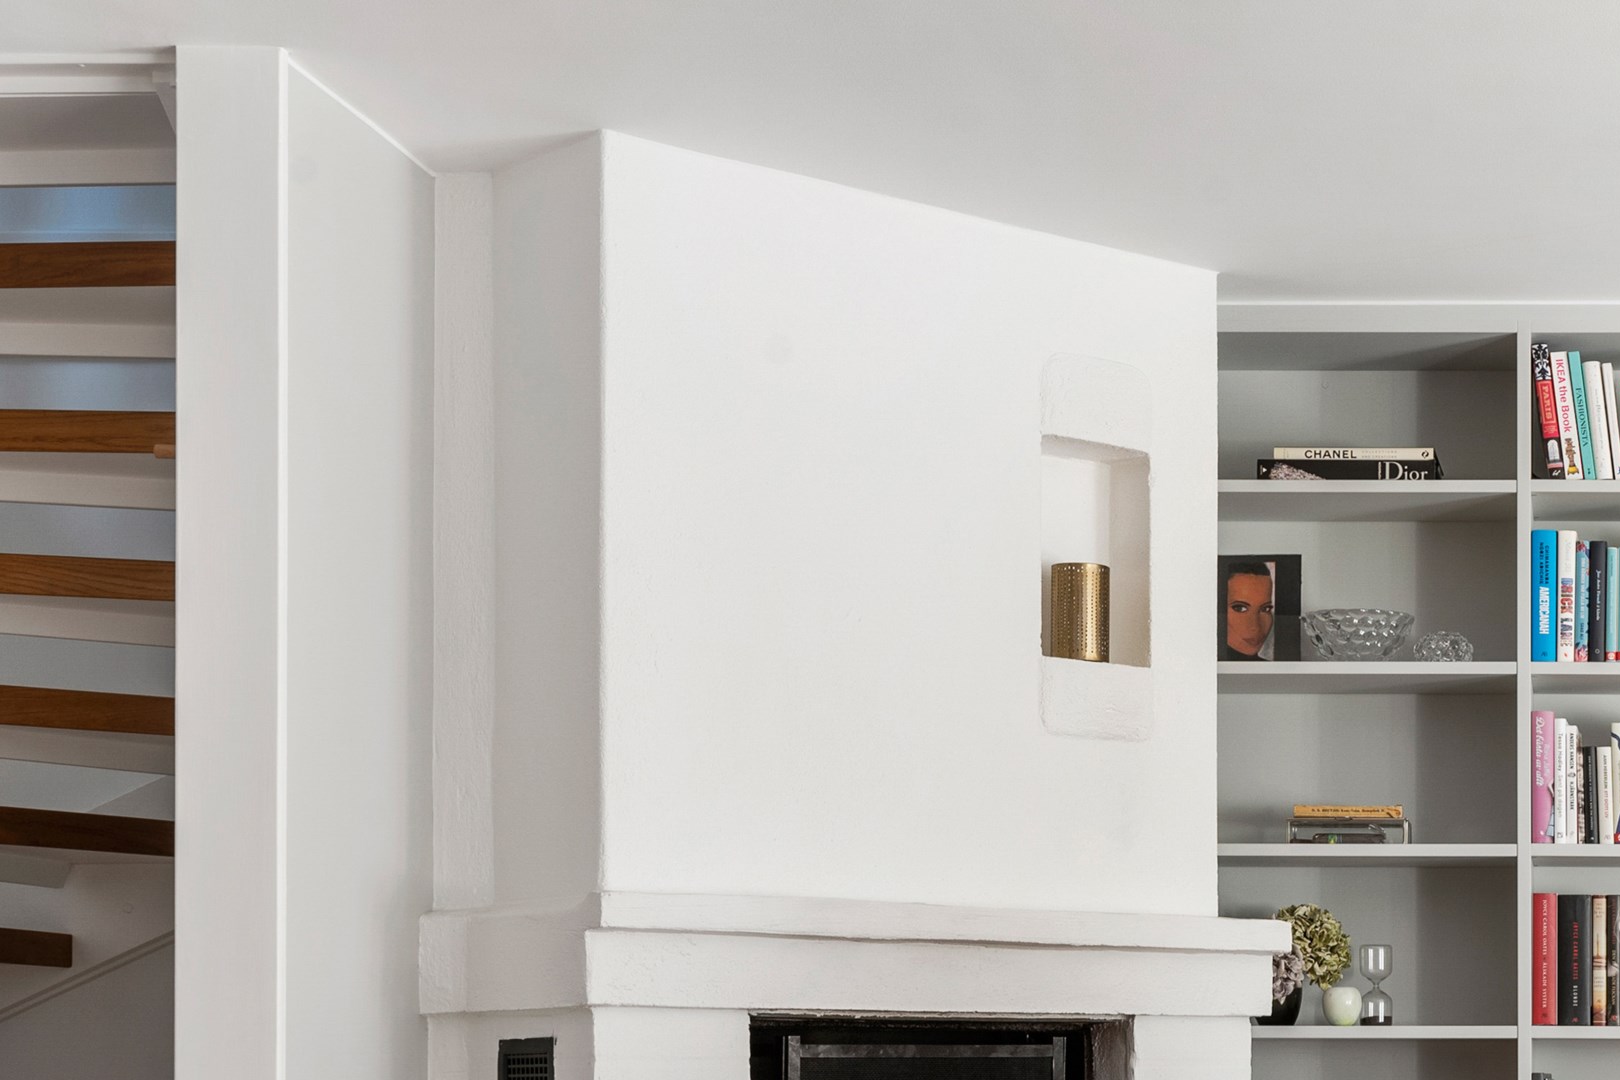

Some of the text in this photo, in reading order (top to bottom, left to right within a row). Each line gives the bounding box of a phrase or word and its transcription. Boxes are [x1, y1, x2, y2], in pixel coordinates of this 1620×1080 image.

[1542, 385, 1553, 419] PARIS
[1555, 359, 1572, 433] IKEA the Book
[1575, 388, 1589, 448] FASHIONISTA
[1304, 449, 1357, 459] CHANEL
[1384, 461, 1428, 480] Dior
[1539, 586, 1550, 634] AMERICANAH
[1560, 578, 1573, 647] BRICK LANE
[1535, 716, 1545, 786] Det bästa av allt
